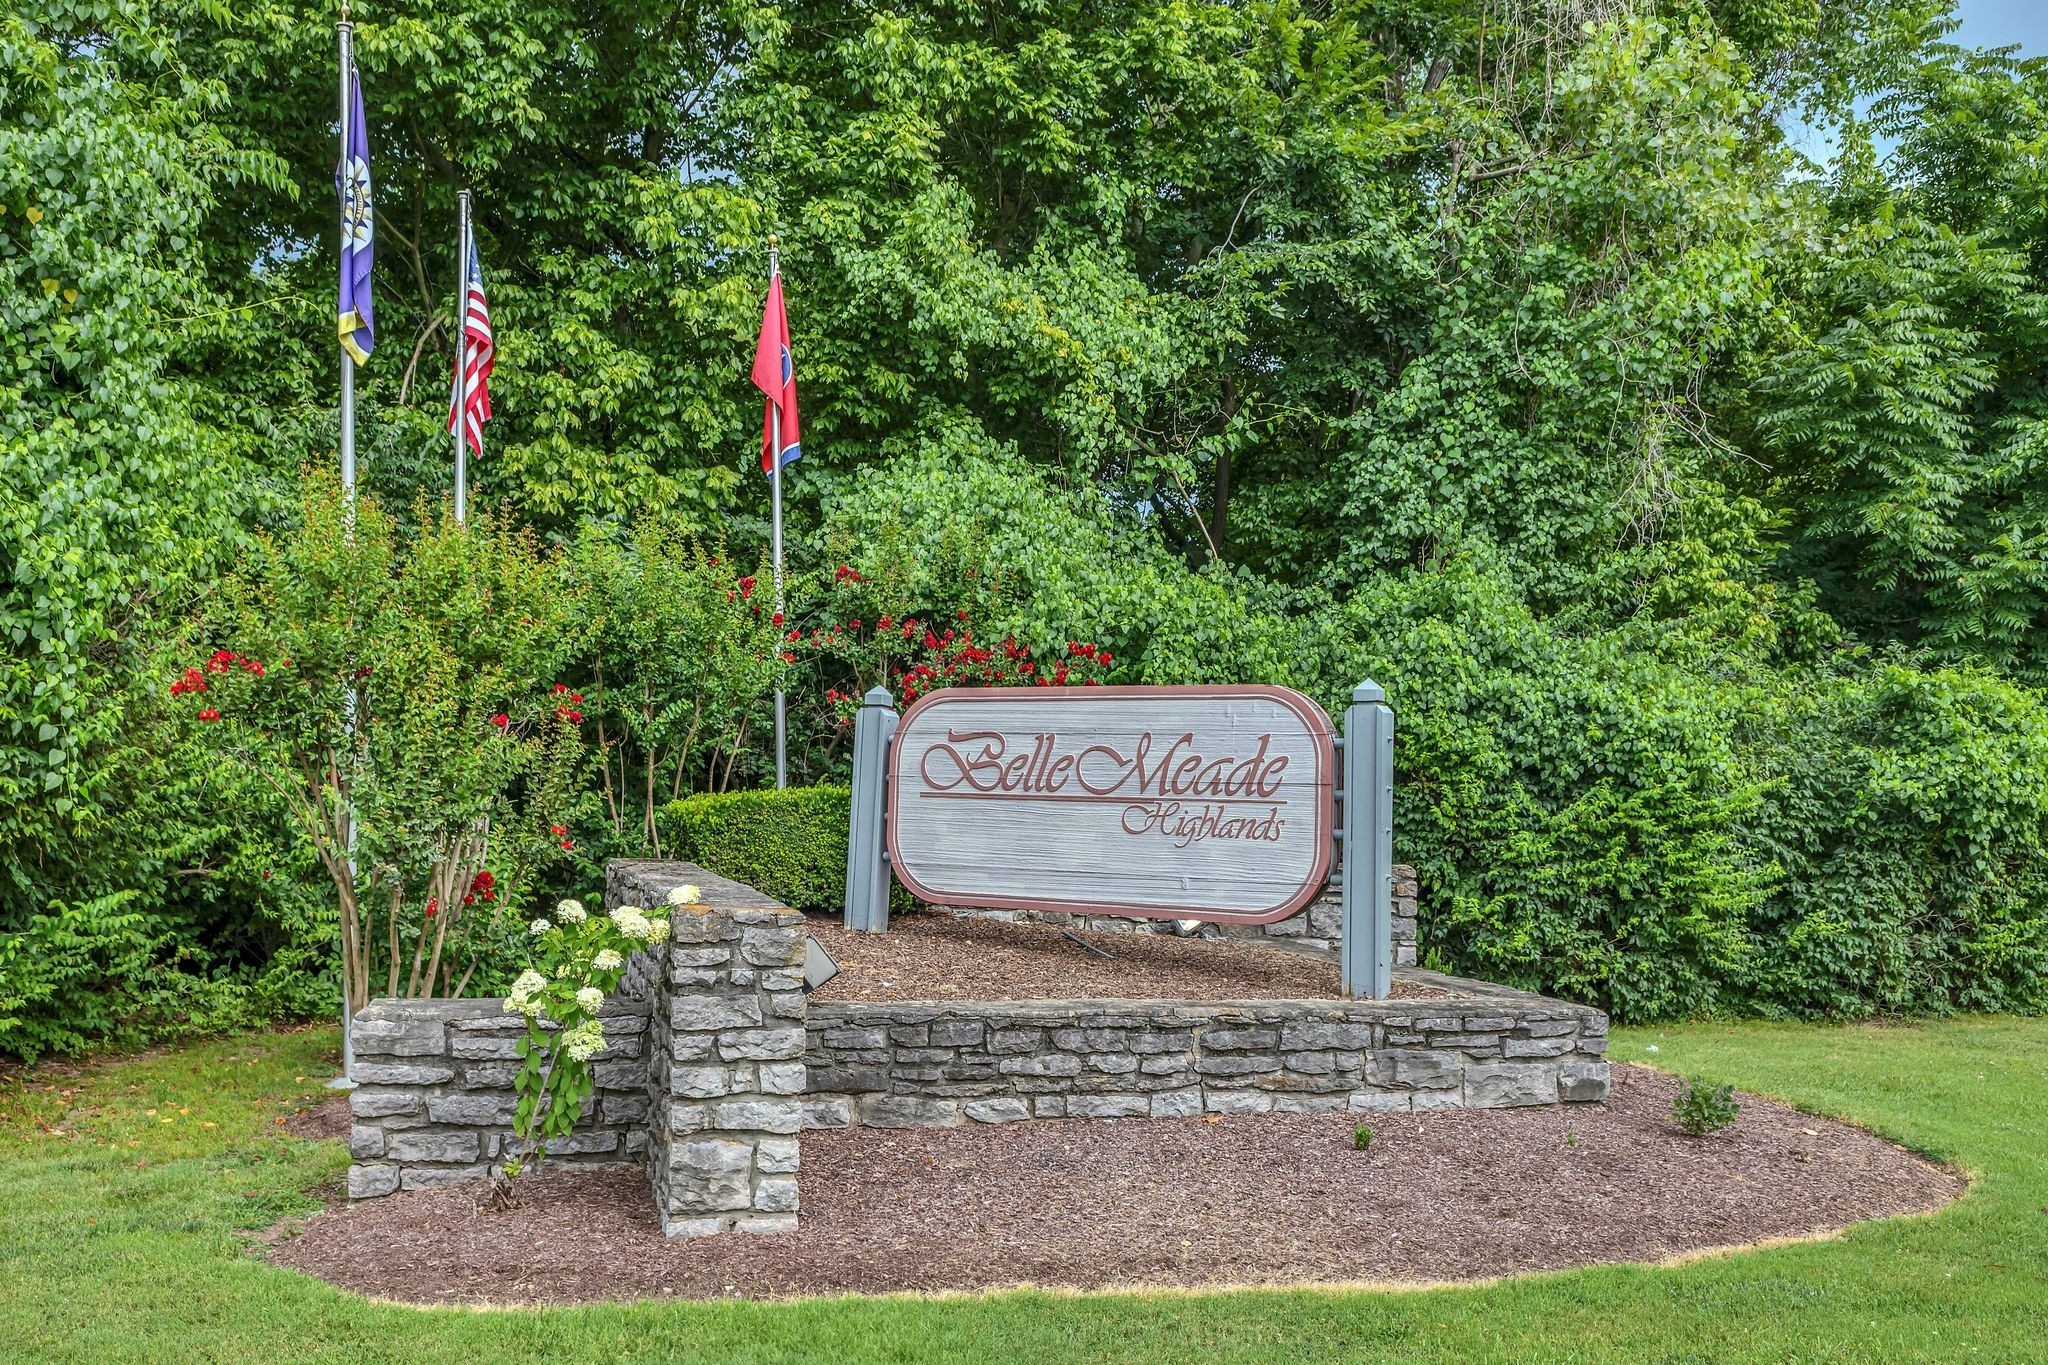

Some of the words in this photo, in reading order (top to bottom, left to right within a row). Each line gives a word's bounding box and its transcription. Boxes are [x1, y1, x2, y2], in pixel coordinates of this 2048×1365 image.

[921, 728, 1075, 792] Belle
[1076, 732, 1290, 797] Meade
[1122, 802, 1285, 848] Highlands
